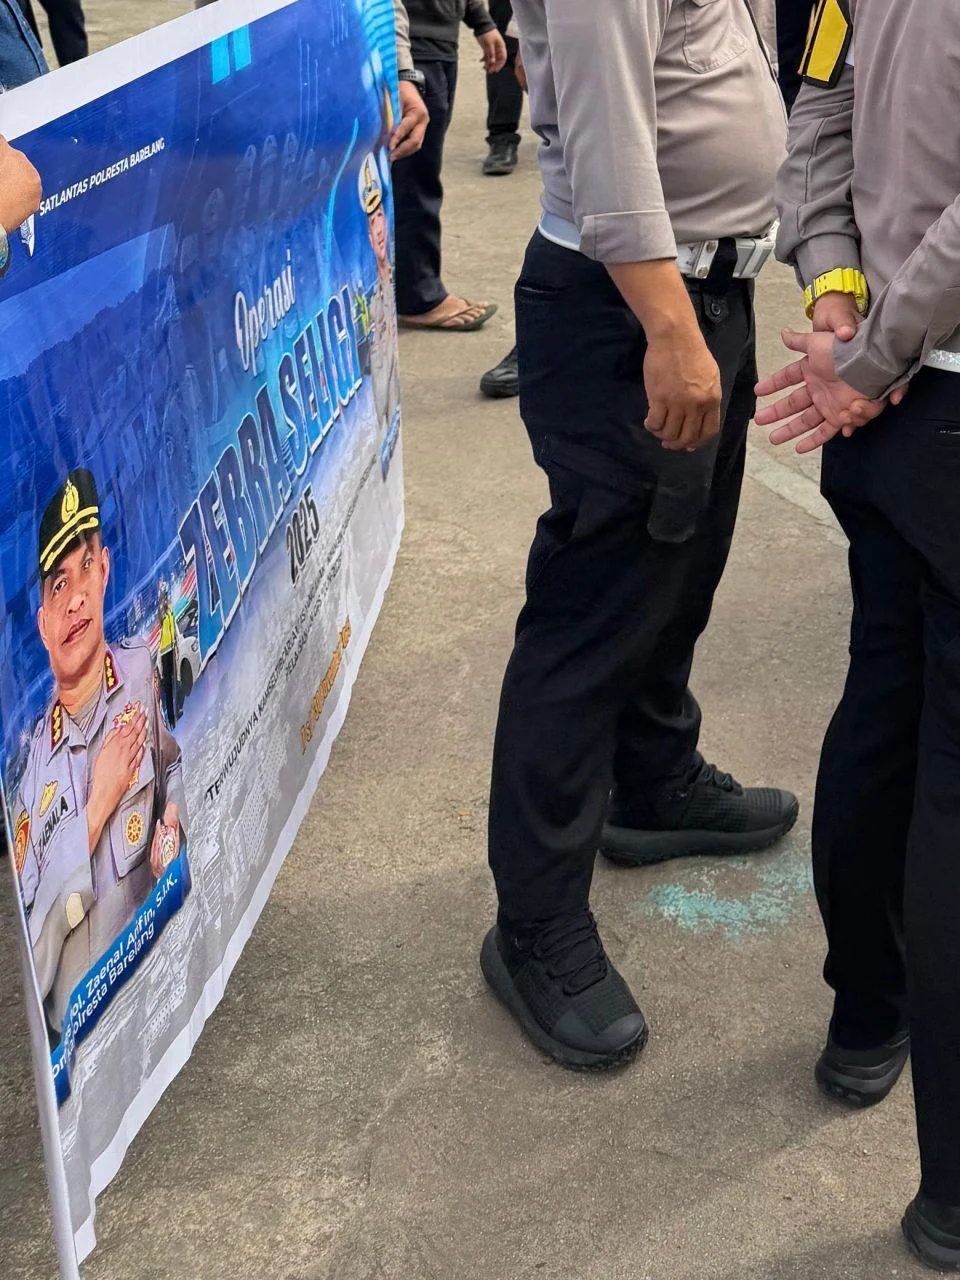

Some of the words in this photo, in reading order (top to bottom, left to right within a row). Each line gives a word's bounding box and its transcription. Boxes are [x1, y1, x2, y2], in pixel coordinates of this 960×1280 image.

[40, 178, 89, 217] SATLANTAS
[89, 157, 129, 189] POLRESTA
[129, 137, 166, 167] BARELANG
[235, 248, 296, 378] Operasi
[179, 383, 292, 674] ZEBRA
[278, 284, 363, 478] SELIGI
[286, 483, 321, 588] 2025
[86, 942, 124, 999] Zaenal
[156, 873, 179, 907] S.I.K.
[109, 922, 155, 986] Barelang
